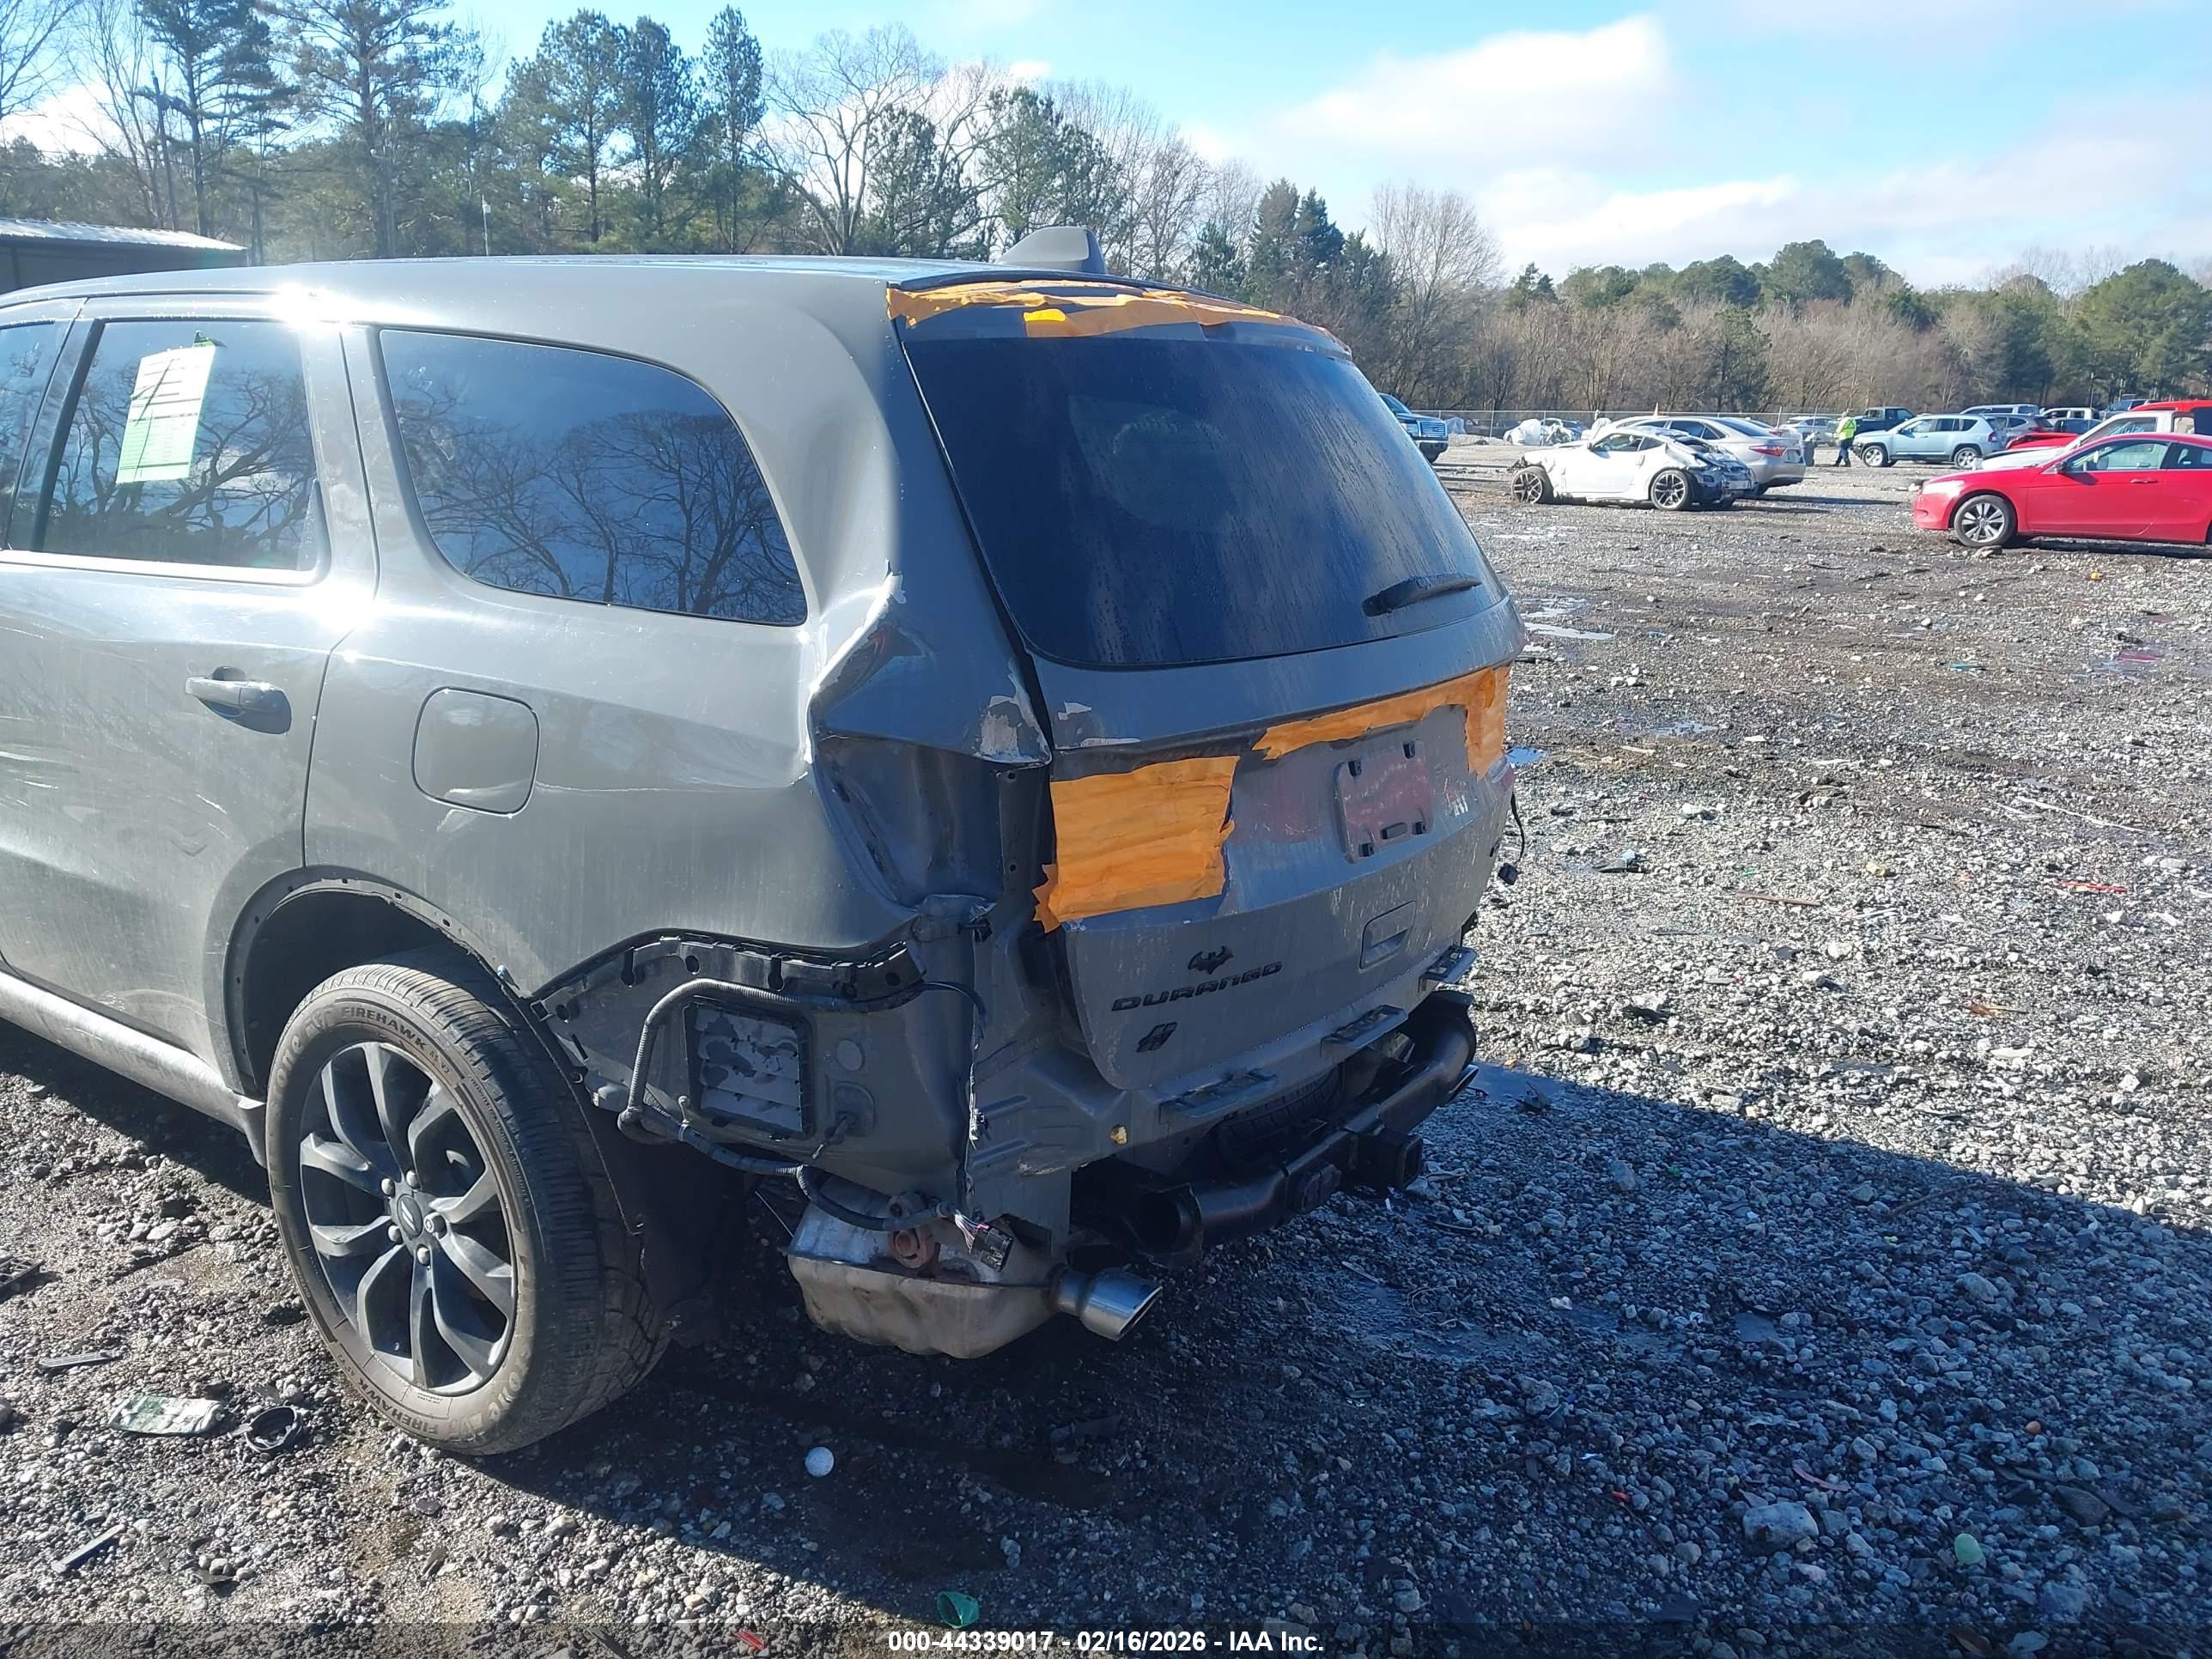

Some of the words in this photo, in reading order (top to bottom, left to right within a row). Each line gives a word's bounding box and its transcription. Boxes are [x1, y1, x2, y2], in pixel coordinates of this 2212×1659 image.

[1111, 961, 1283, 1012] DURANGO
[340, 1006, 427, 1050] FIREHAWK
[358, 1379, 440, 1435] FIREHAWK
